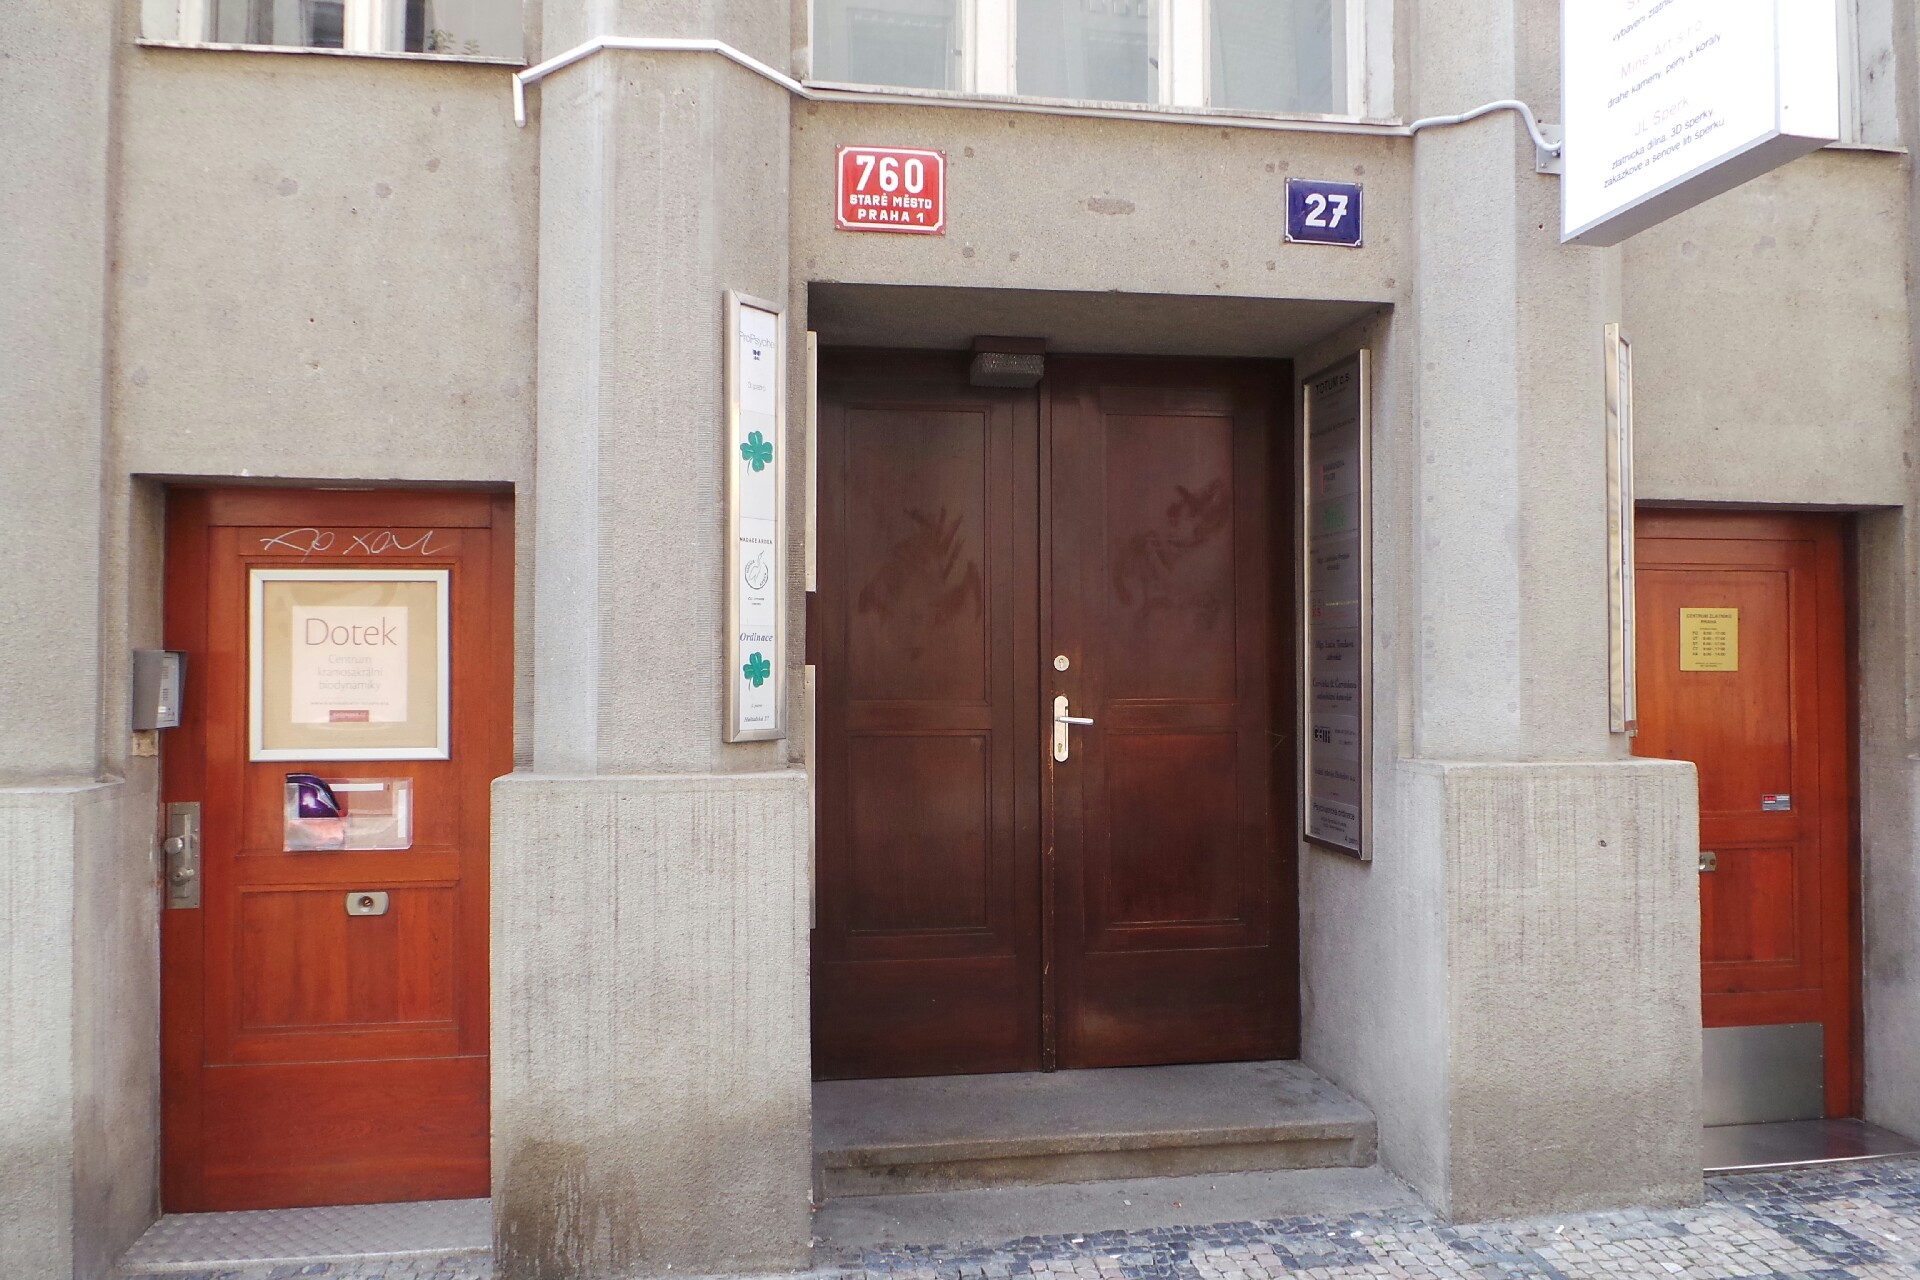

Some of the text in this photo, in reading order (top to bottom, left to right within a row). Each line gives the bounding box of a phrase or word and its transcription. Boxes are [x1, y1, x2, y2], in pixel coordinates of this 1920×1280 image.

[1670, 123, 1683, 138] 3D
[856, 155, 924, 194] 760
[849, 193, 932, 209] STARÉ MĚSTO
[857, 209, 924, 223] PRAHA 1
[1305, 193, 1348, 228] 27
[305, 616, 397, 646] Dotek
[740, 632, 774, 643] Ordinace
[328, 654, 372, 664] Centrum
